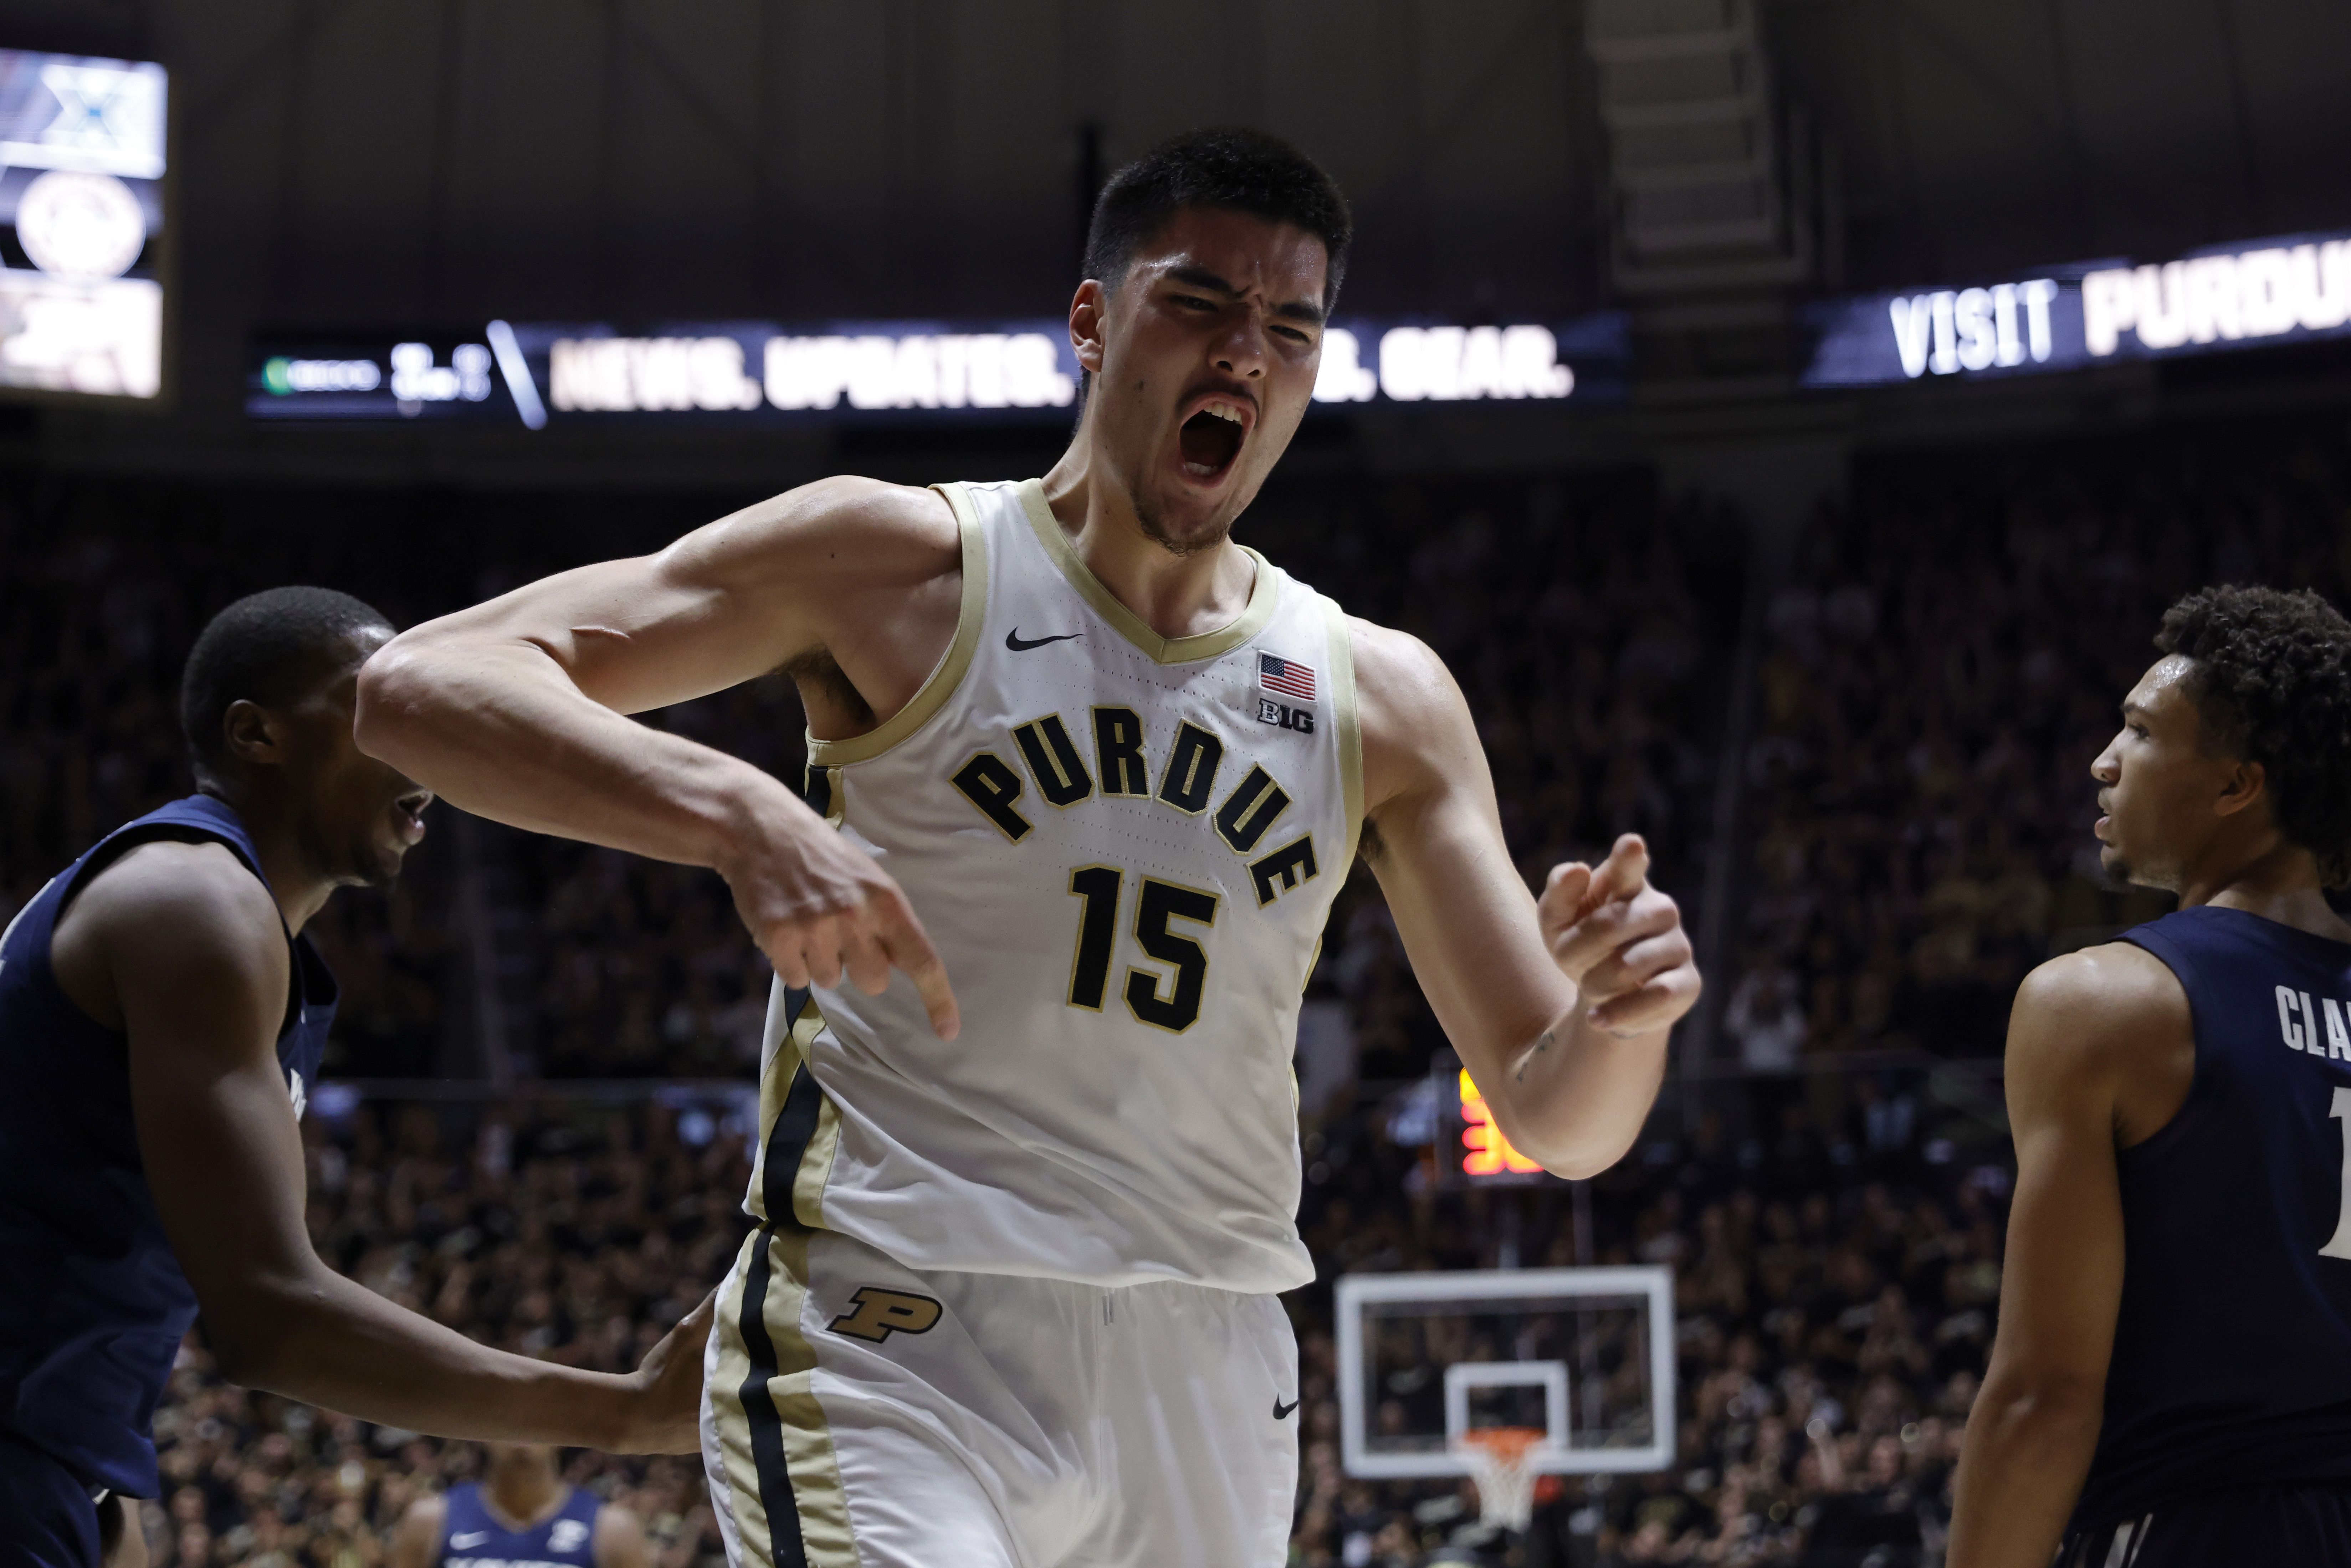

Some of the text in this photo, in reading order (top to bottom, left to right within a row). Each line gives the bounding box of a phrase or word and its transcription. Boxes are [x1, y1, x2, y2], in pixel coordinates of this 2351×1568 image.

[1890, 239, 2351, 378] VISIT PURDU
[764, 333, 1072, 409] UPDATES.
[1380, 324, 1574, 401] GEAR.
[947, 704, 1320, 909] PURDUE
[1067, 862, 1221, 1036] 15
[2275, 985, 2351, 1062] CLA
[824, 1286, 943, 1344] P
